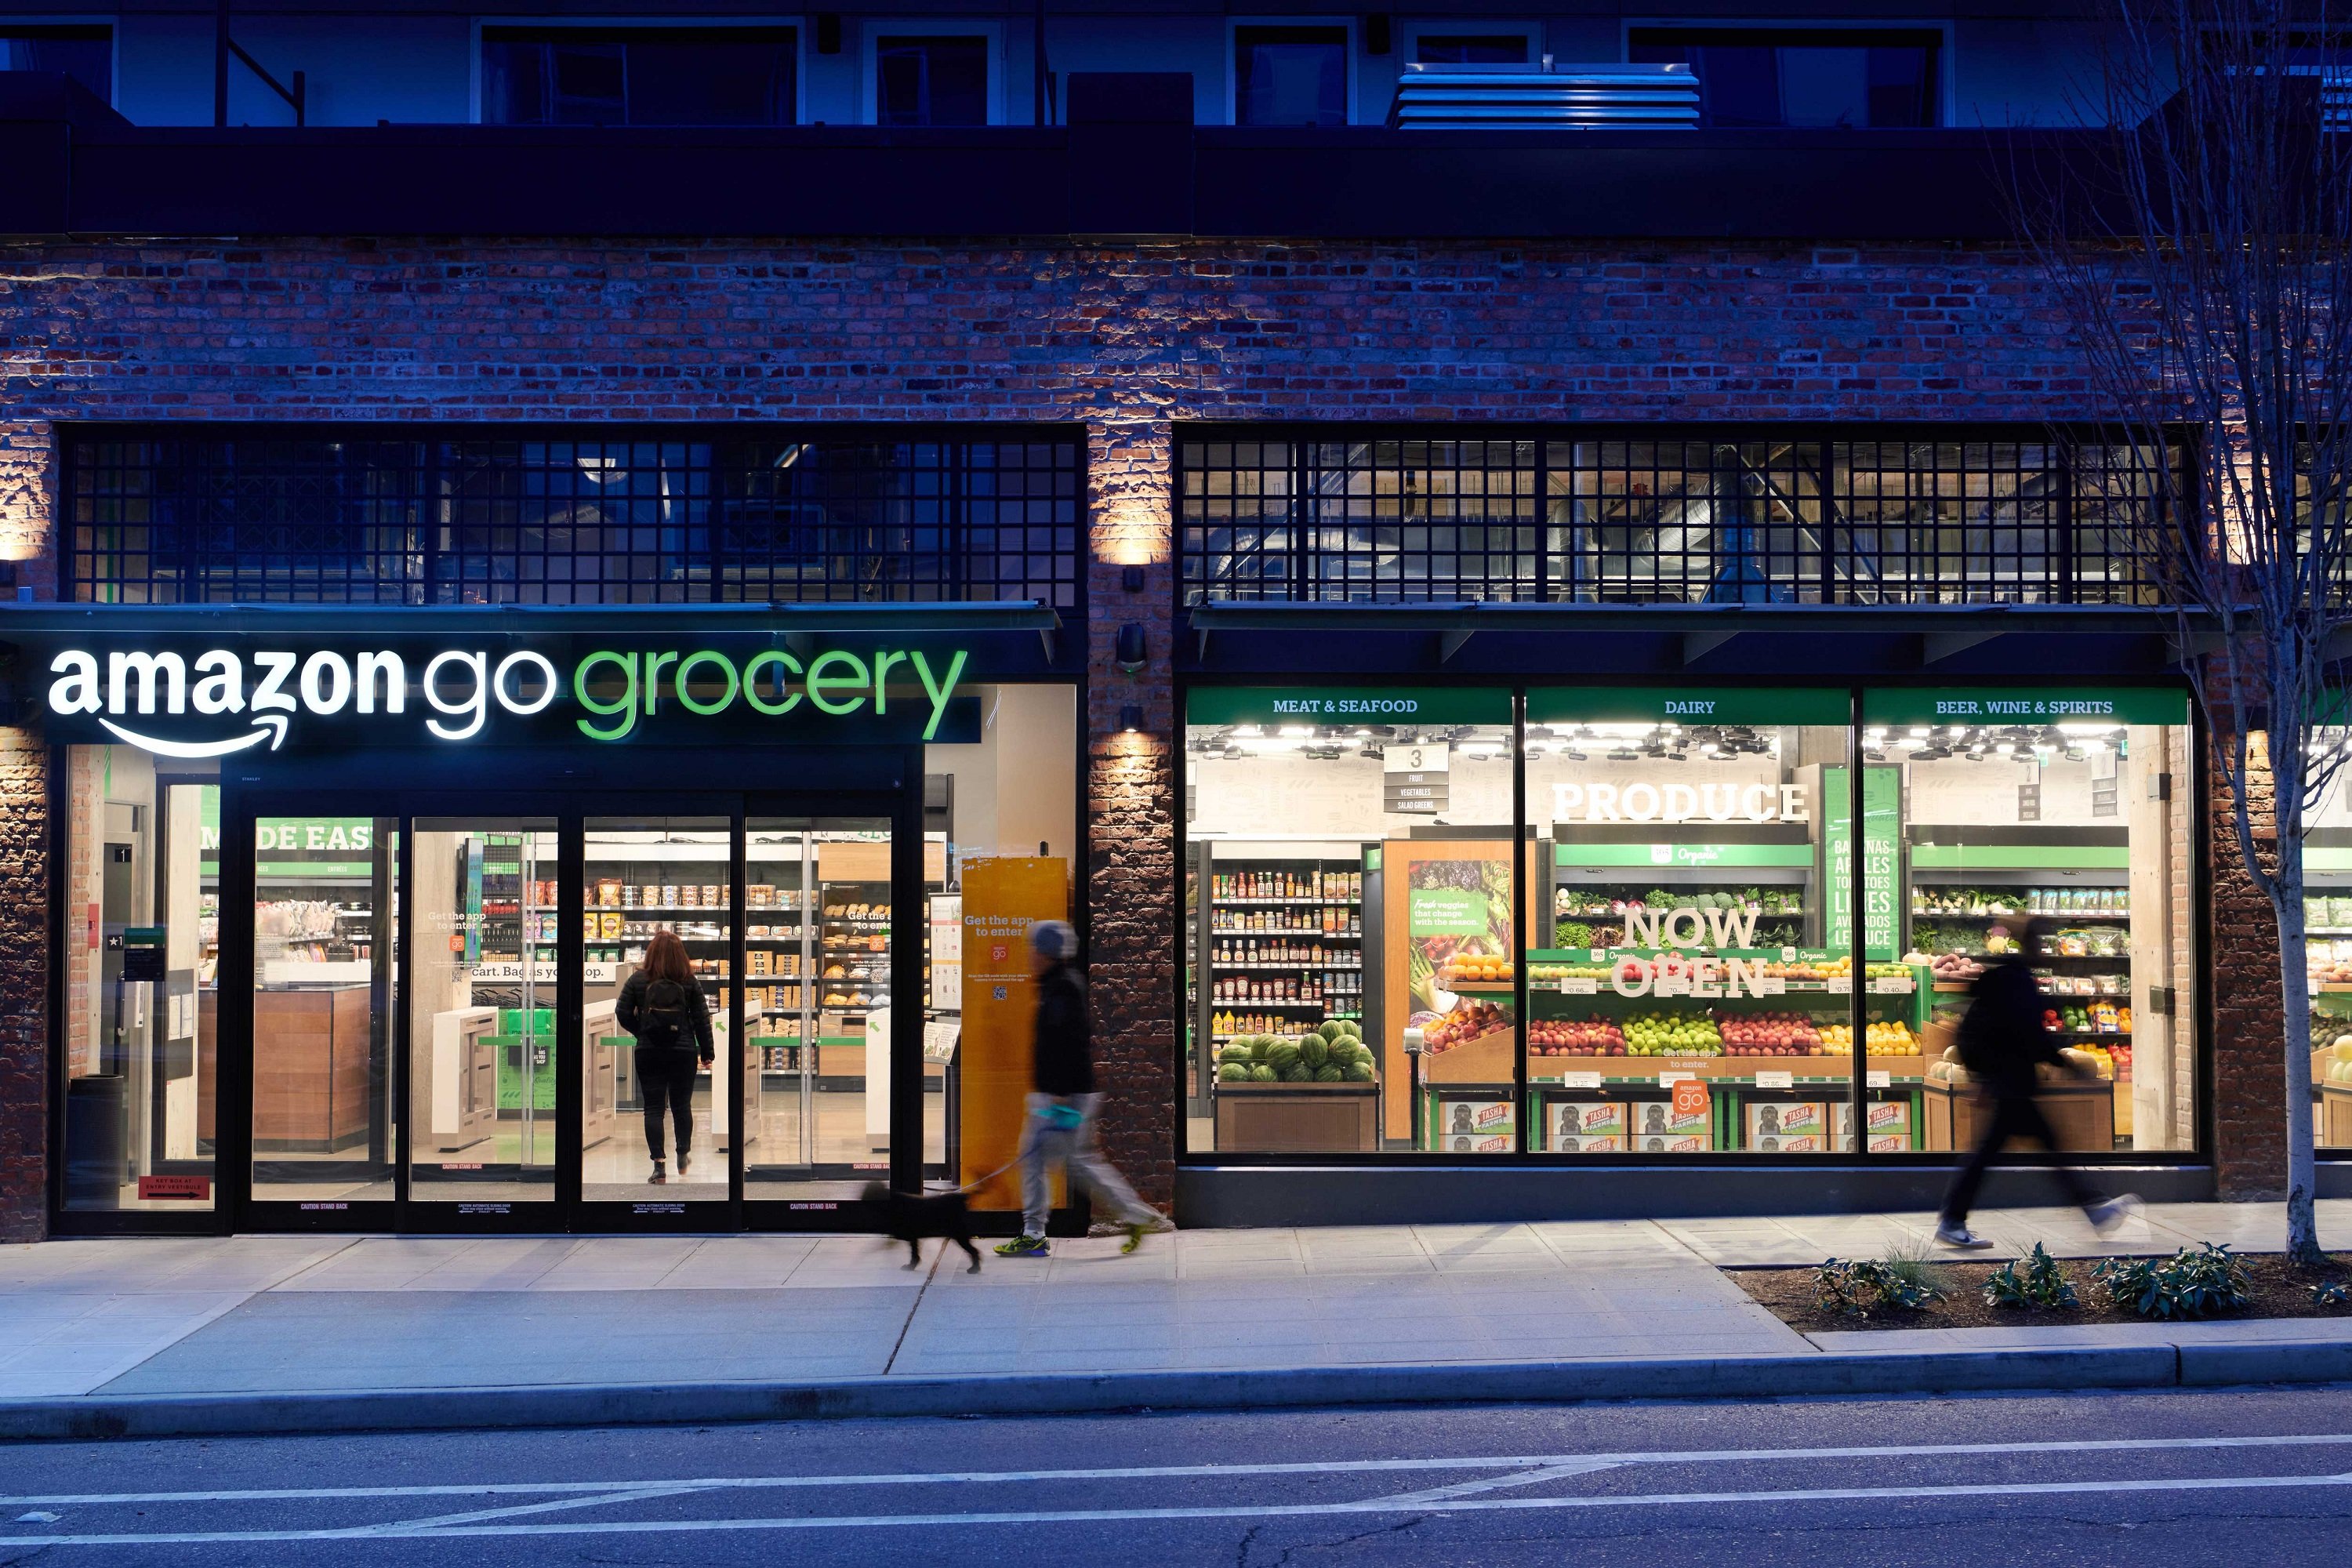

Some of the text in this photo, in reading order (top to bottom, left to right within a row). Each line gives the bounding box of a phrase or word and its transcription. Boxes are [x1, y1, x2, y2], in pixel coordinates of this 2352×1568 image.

[49, 650, 968, 740] amazon go grocery
[1273, 700, 1417, 713] MEAT & SEAFOOD
[1664, 701, 1715, 713] DAIRY
[1936, 701, 2113, 715] BEER, WINE & SPIRITS
[1410, 749, 1422, 768] 3
[1400, 788, 1431, 797] VEGETABLES
[1414, 800, 1433, 809] GREENS
[1552, 783, 1810, 821] PRODUCE
[201, 826, 372, 850] MDE EAS
[1835, 840, 1890, 855] BANAS
[1835, 857, 1890, 874] APLES
[1835, 876, 1890, 889] TOTOES
[1437, 902, 1468, 911] veggies
[1835, 891, 1890, 913] LIES
[428, 911, 486, 922] Get the app
[848, 912, 866, 920] Get
[869, 911, 885, 920] the
[964, 915, 1034, 927] Get the app
[1432, 910, 1462, 920] change
[869, 921, 891, 930] ente
[1621, 907, 1762, 949] NOW
[1835, 916, 1890, 928] AVOADOS
[975, 927, 1023, 936] to enter
[1835, 930, 1890, 946] LEUCE
[452, 941, 463, 949] go
[871, 941, 883, 949] go
[993, 950, 1007, 960] go
[1799, 951, 1828, 960] Organic
[472, 967, 499, 977] cart.
[1612, 957, 1768, 998] OPEN
[1679, 1094, 1704, 1111] go
[1482, 1106, 1503, 1120] TASHA
[1590, 1107, 1611, 1122] TASHA
[1788, 1106, 1809, 1121] TASHA
[1872, 1106, 1893, 1121] TASHA
[1482, 1118, 1503, 1129] FARMS
[1589, 1120, 1610, 1131] FARMS
[1674, 1119, 1696, 1130] FARMS
[1788, 1119, 1809, 1130] FARMS
[1872, 1119, 1893, 1130] FARMS
[1482, 1138, 1502, 1152] TASHA
[1590, 1139, 1610, 1152] TASHA
[1675, 1139, 1696, 1152] TASHA
[1790, 1139, 1809, 1152] TASHA
[1875, 1139, 1895, 1152] TASHA
